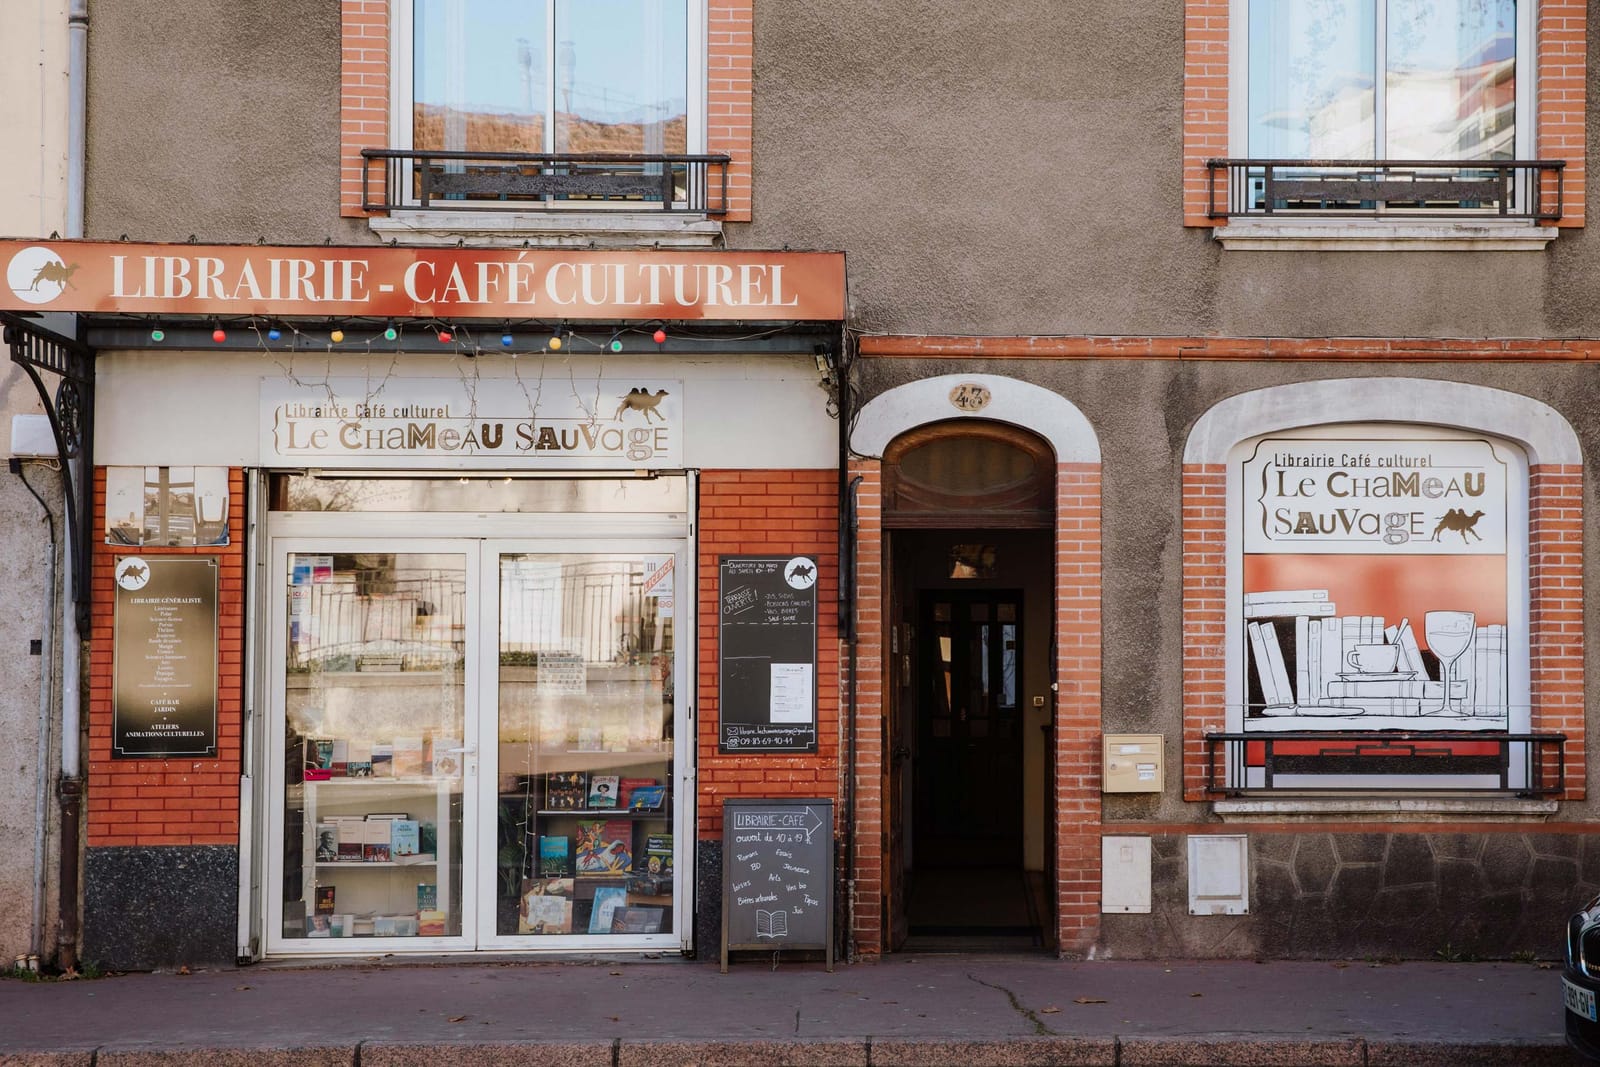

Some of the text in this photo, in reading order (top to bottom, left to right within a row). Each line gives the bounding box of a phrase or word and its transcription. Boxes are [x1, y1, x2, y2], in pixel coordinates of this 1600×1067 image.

[110, 255, 370, 302] LIBRAIRIE
[403, 251, 535, 304] CAFÉ
[545, 262, 798, 307] CULTUREL
[954, 386, 983, 408] 47
[285, 403, 450, 418] Librairie Café culturel
[287, 421, 329, 450] Le
[1274, 453, 1432, 467] Librairie Café culturel
[1275, 470, 1316, 498] Le
[764, 831, 773, 842] de
[776, 833, 786, 843] 10
[794, 834, 803, 842] 19
[750, 862, 762, 871] BD
